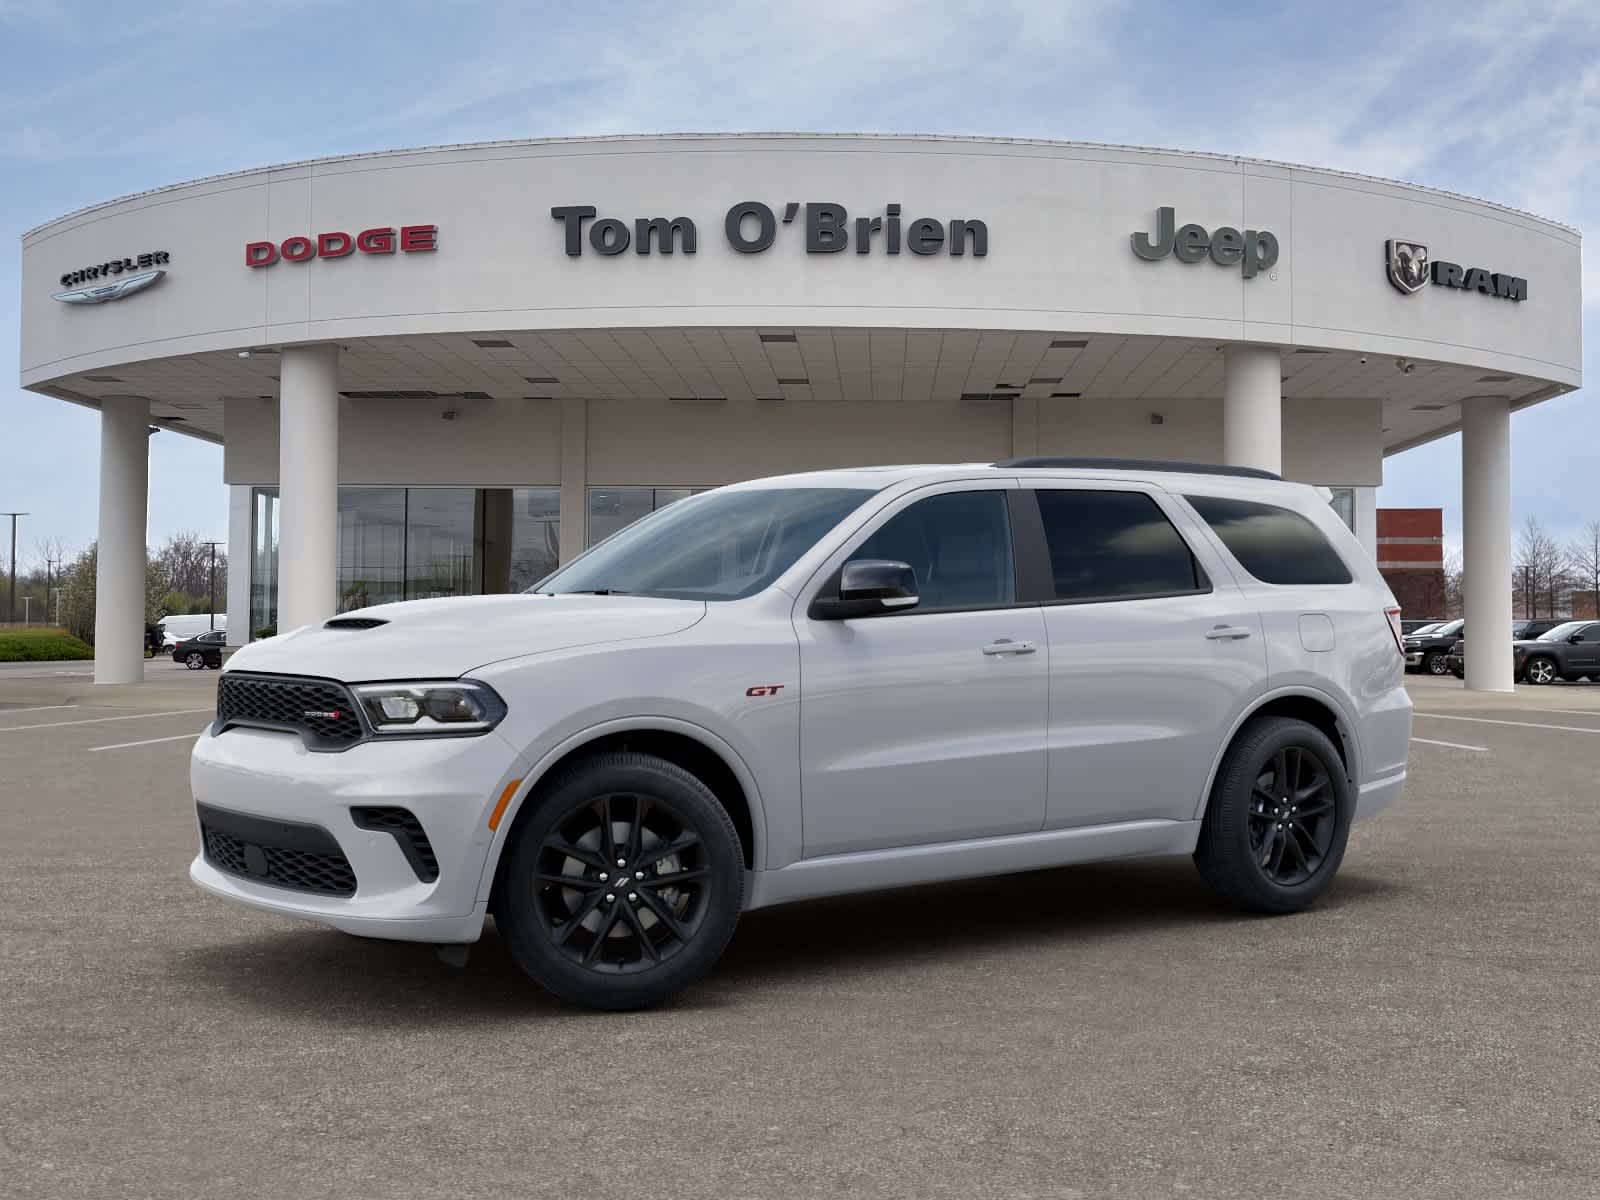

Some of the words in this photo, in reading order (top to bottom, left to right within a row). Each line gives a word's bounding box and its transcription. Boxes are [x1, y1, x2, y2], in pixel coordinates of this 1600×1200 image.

[246, 225, 437, 268] DODGE
[551, 205, 697, 256] Tom
[1130, 207, 1279, 278] Jeep
[60, 251, 170, 287] CHRYSLER
[1431, 260, 1527, 302] RAM
[746, 685, 784, 696] GT
